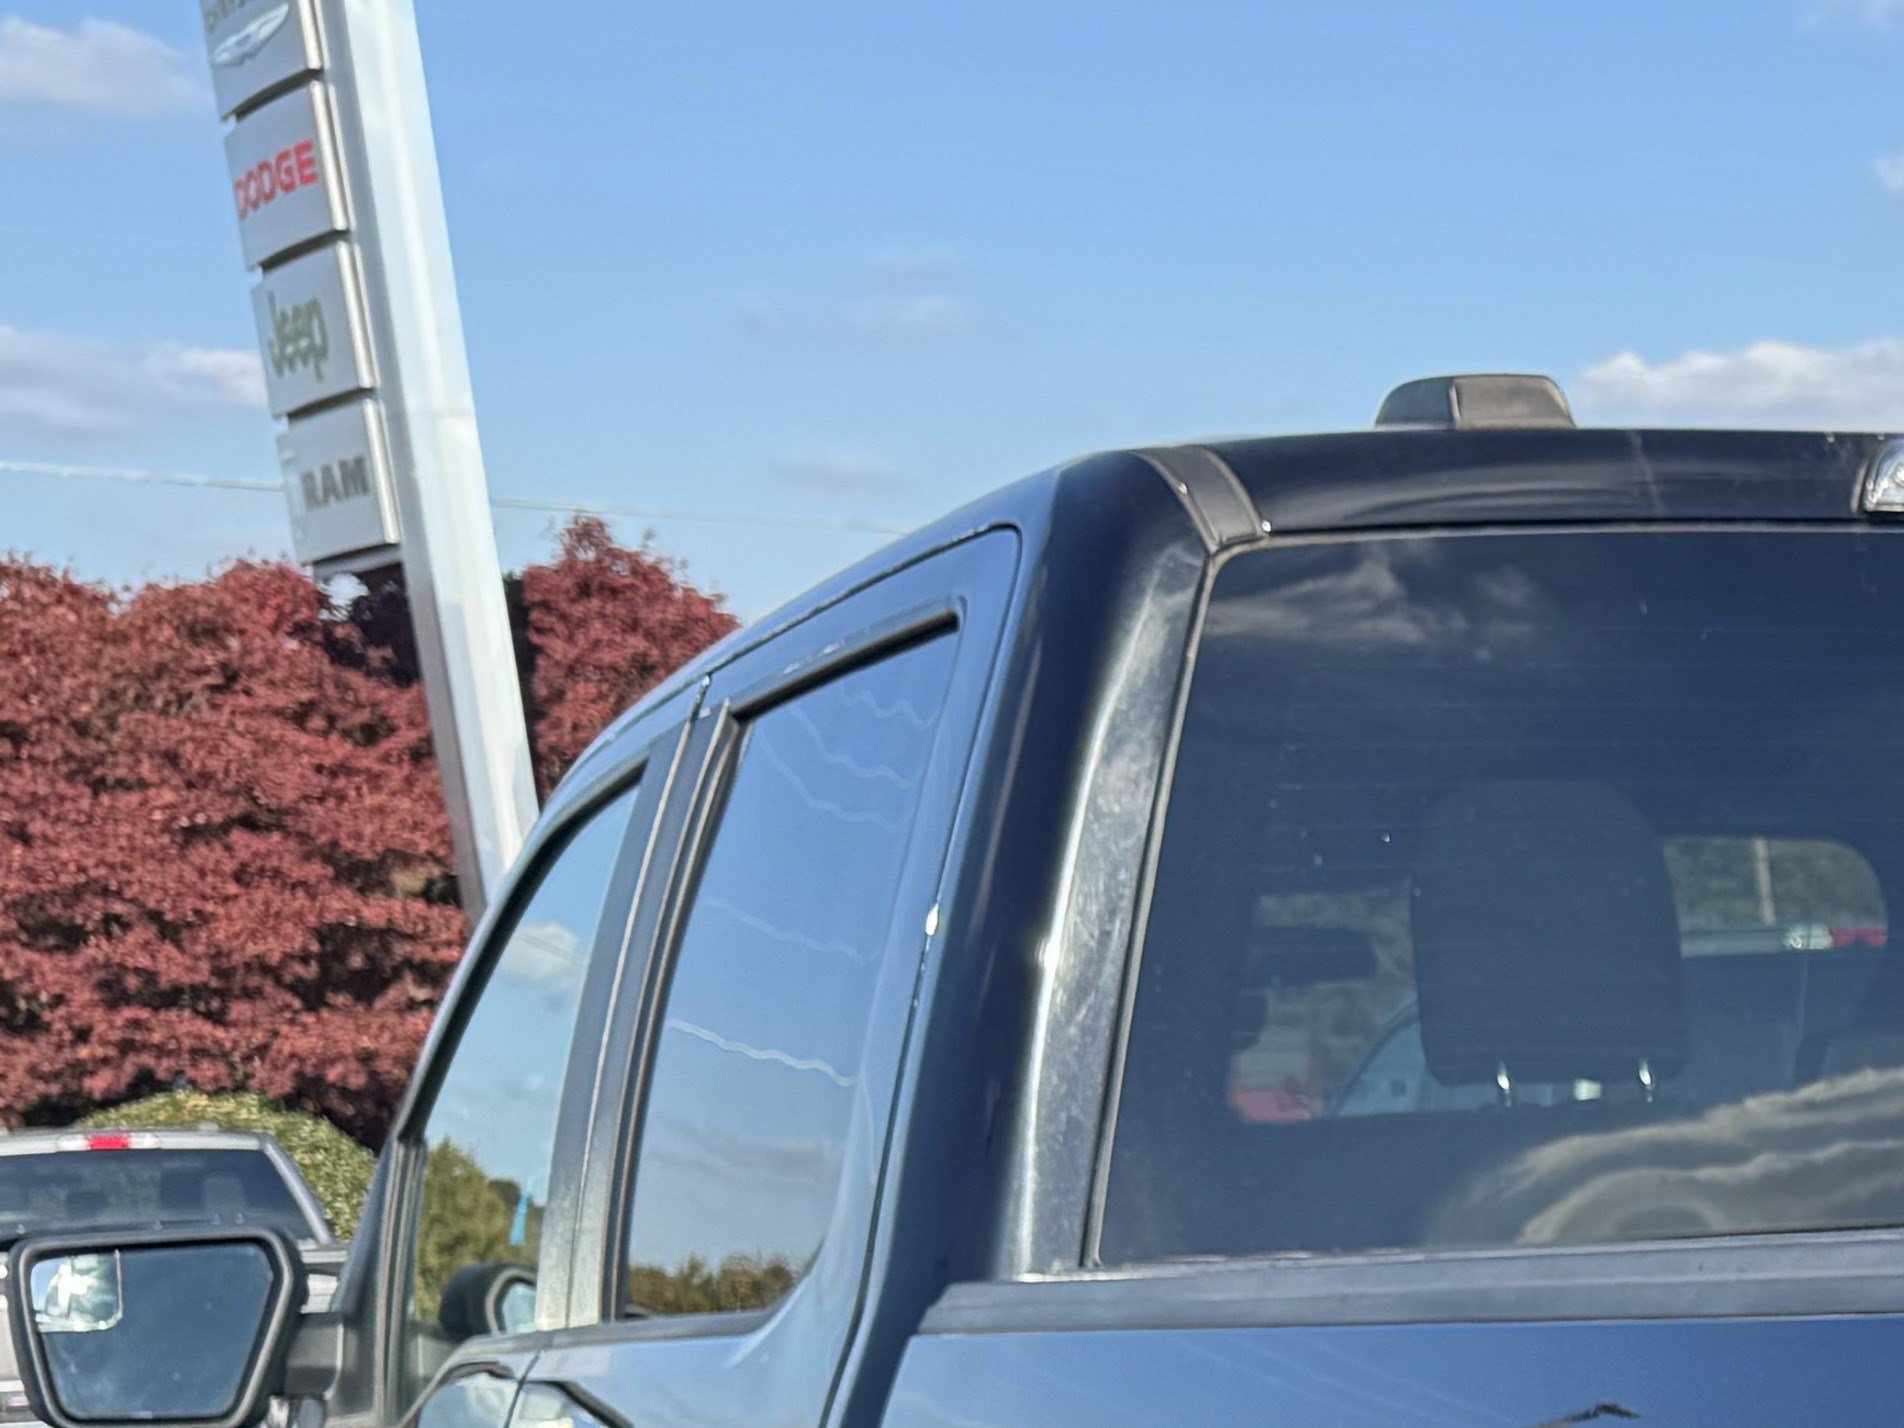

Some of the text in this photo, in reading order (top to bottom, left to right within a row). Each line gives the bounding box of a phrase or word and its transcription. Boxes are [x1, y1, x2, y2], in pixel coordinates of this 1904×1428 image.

[234, 140, 319, 221] DODGE
[268, 290, 329, 384] Jeep
[301, 455, 370, 512] RAM
